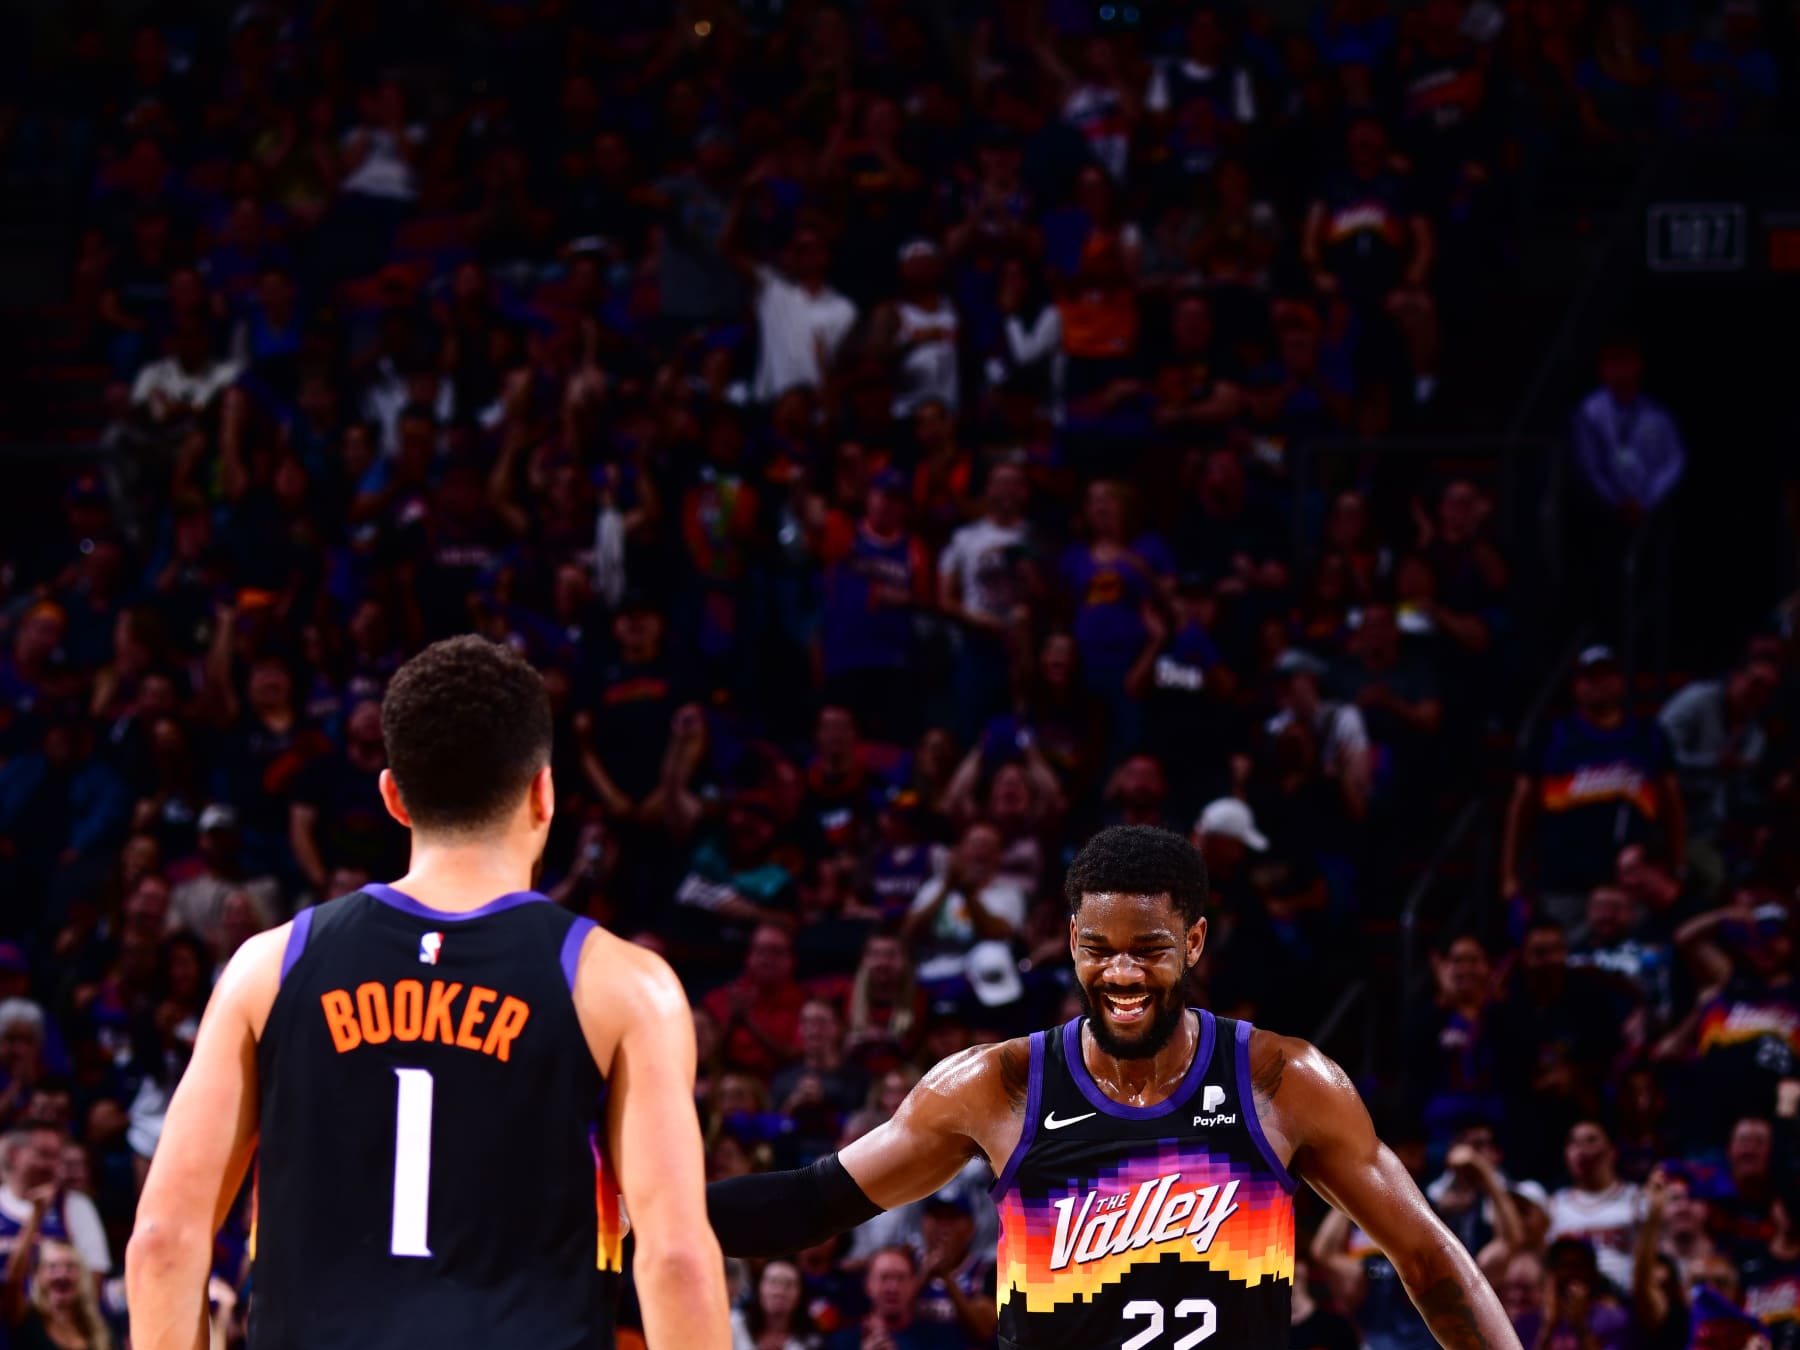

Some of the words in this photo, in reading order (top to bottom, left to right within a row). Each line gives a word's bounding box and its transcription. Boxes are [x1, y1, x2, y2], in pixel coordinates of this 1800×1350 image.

[321, 979, 530, 1062] BOOKER
[391, 1067, 433, 1256] 1
[1193, 1113, 1236, 1127] PayPal
[1050, 1173, 1240, 1270] Valley
[1096, 1192, 1130, 1213] THE
